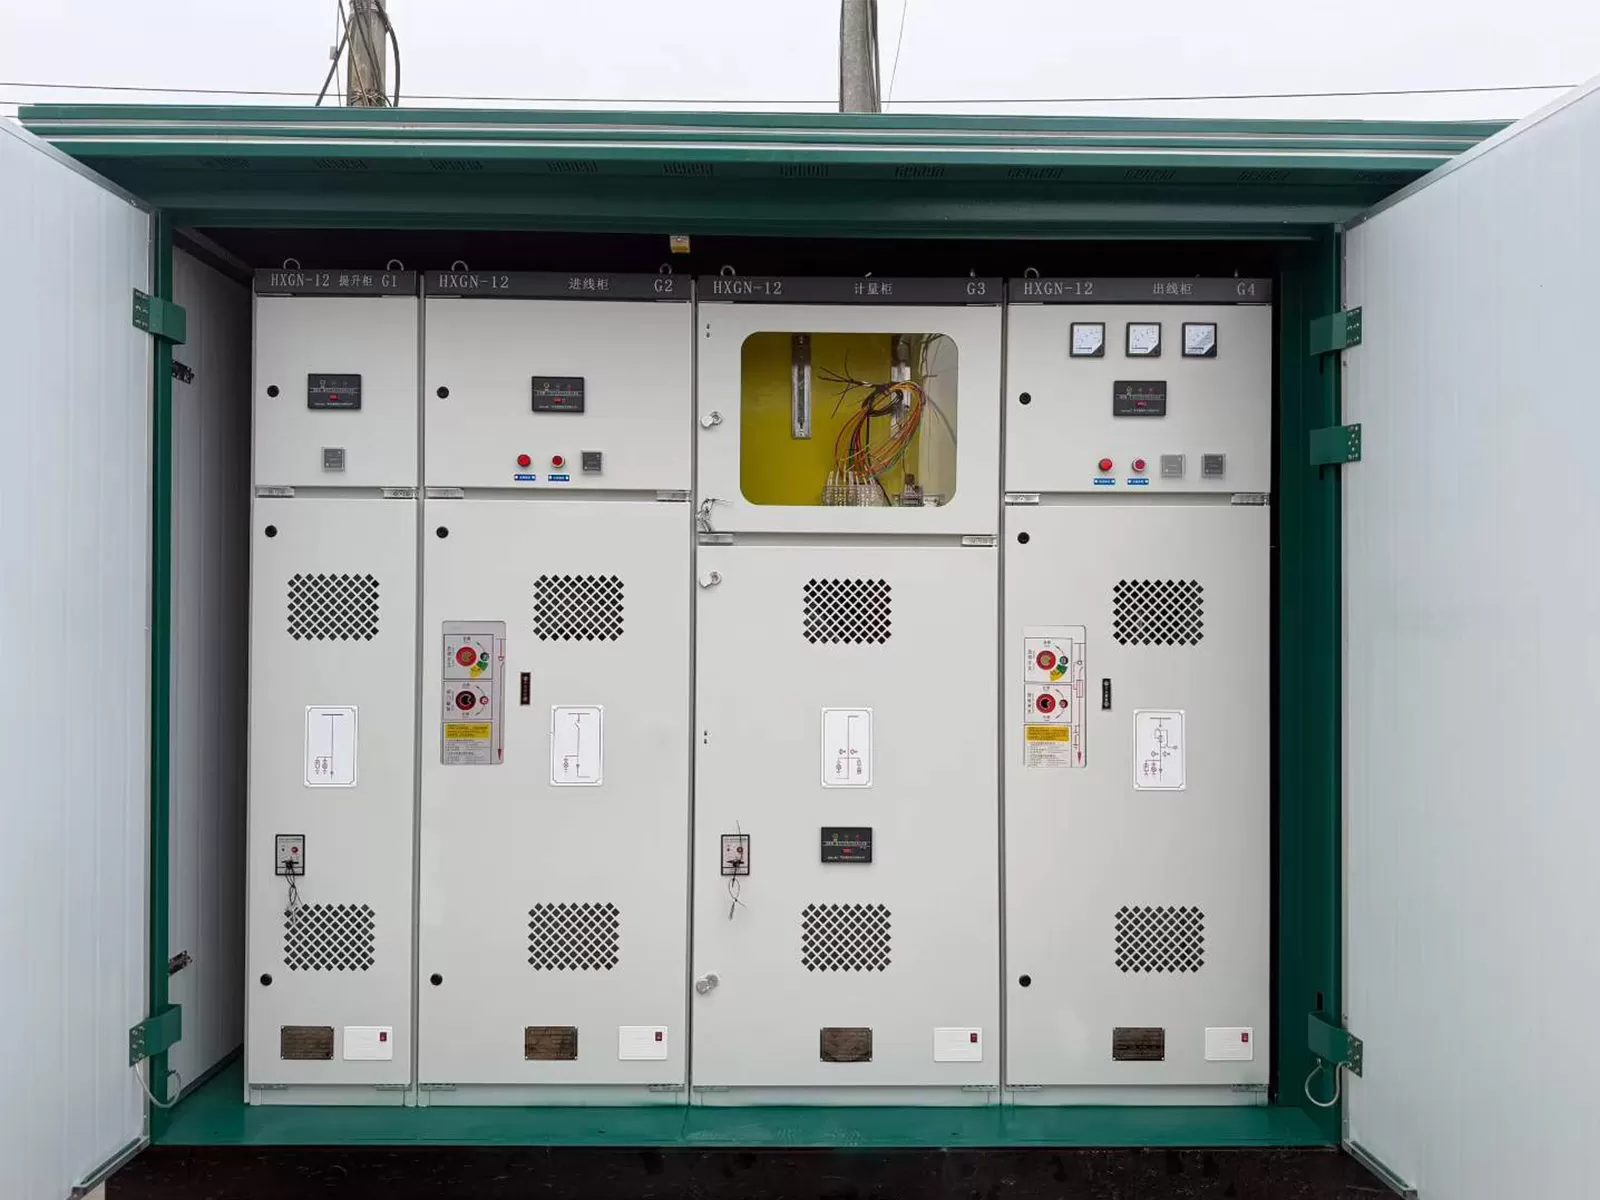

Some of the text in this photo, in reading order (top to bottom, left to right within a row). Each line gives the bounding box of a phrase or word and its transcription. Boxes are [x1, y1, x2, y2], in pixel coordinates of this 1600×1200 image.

[271, 273, 398, 288] HXGN-12 提升柜 G1
[438, 274, 674, 293] HXGN-12 进线柜 G2
[712, 280, 987, 297] HXGN-12 计量柜 G3
[1023, 281, 1256, 297] HXGN-12 出线柜 G4
